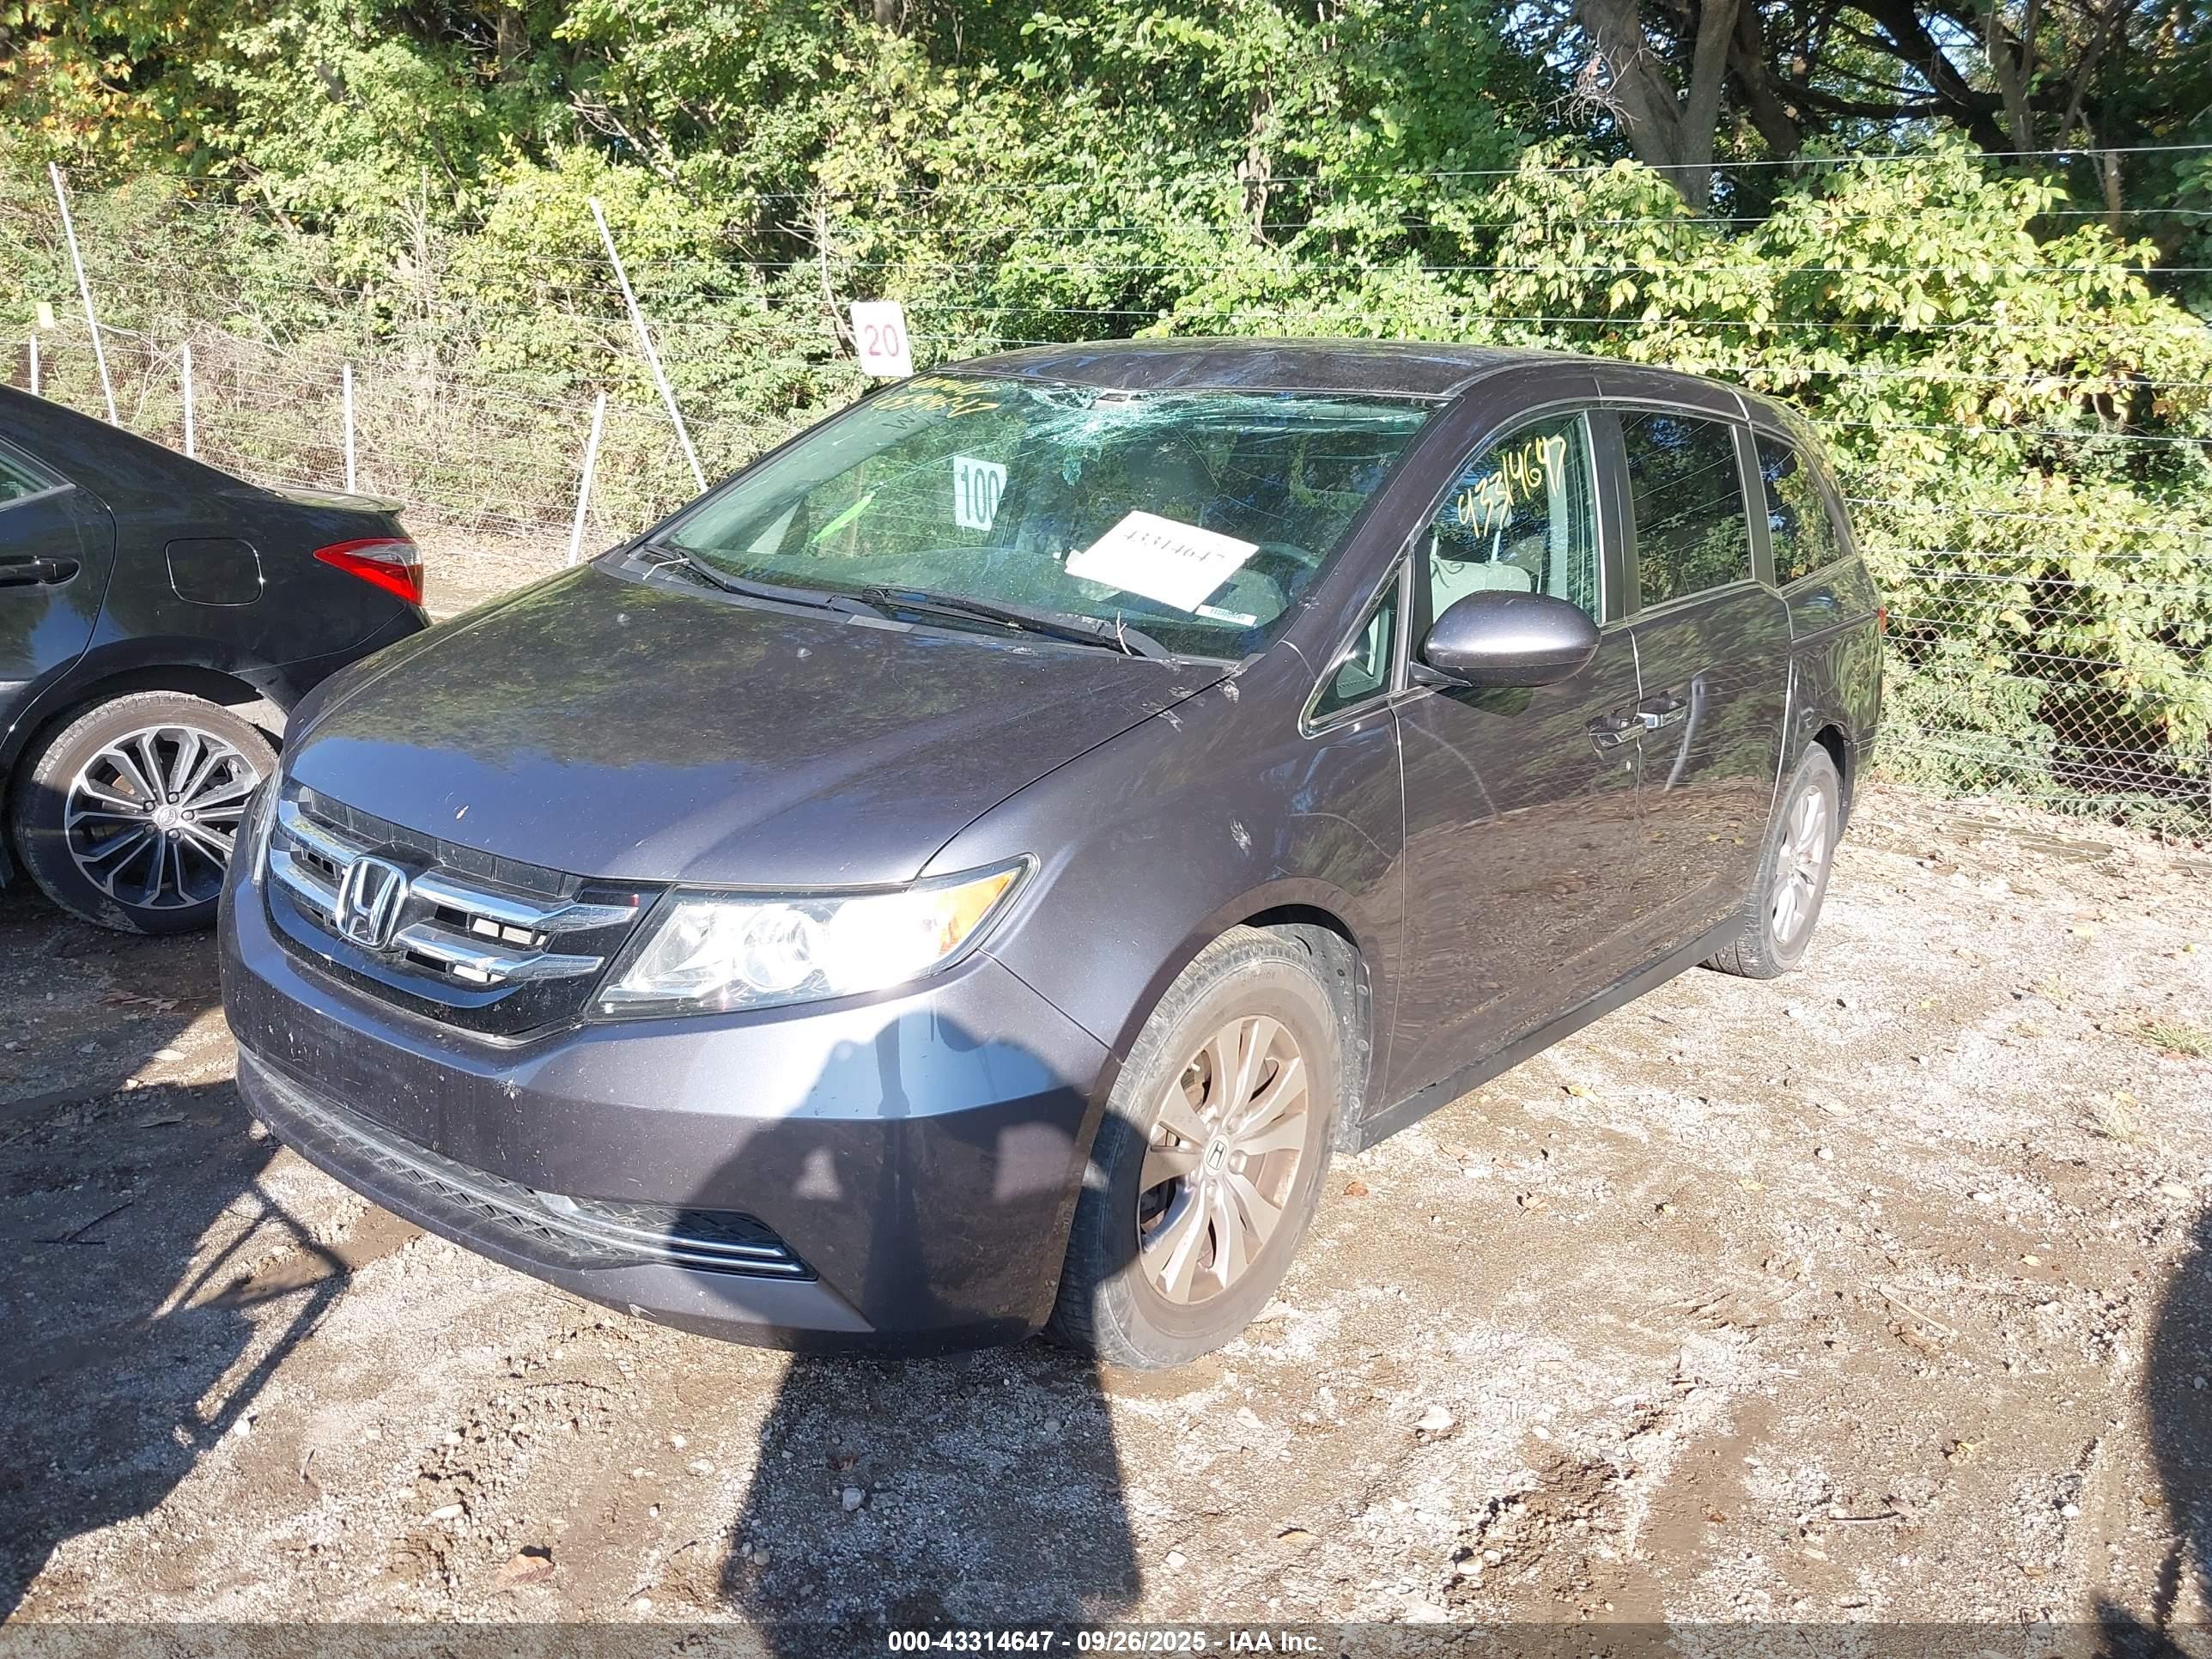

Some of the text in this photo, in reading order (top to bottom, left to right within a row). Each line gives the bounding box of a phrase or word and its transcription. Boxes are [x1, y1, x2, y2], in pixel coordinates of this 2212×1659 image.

[865, 324, 899, 357] 20
[961, 465, 1000, 524] 100
[1458, 434, 1567, 538] 43314647
